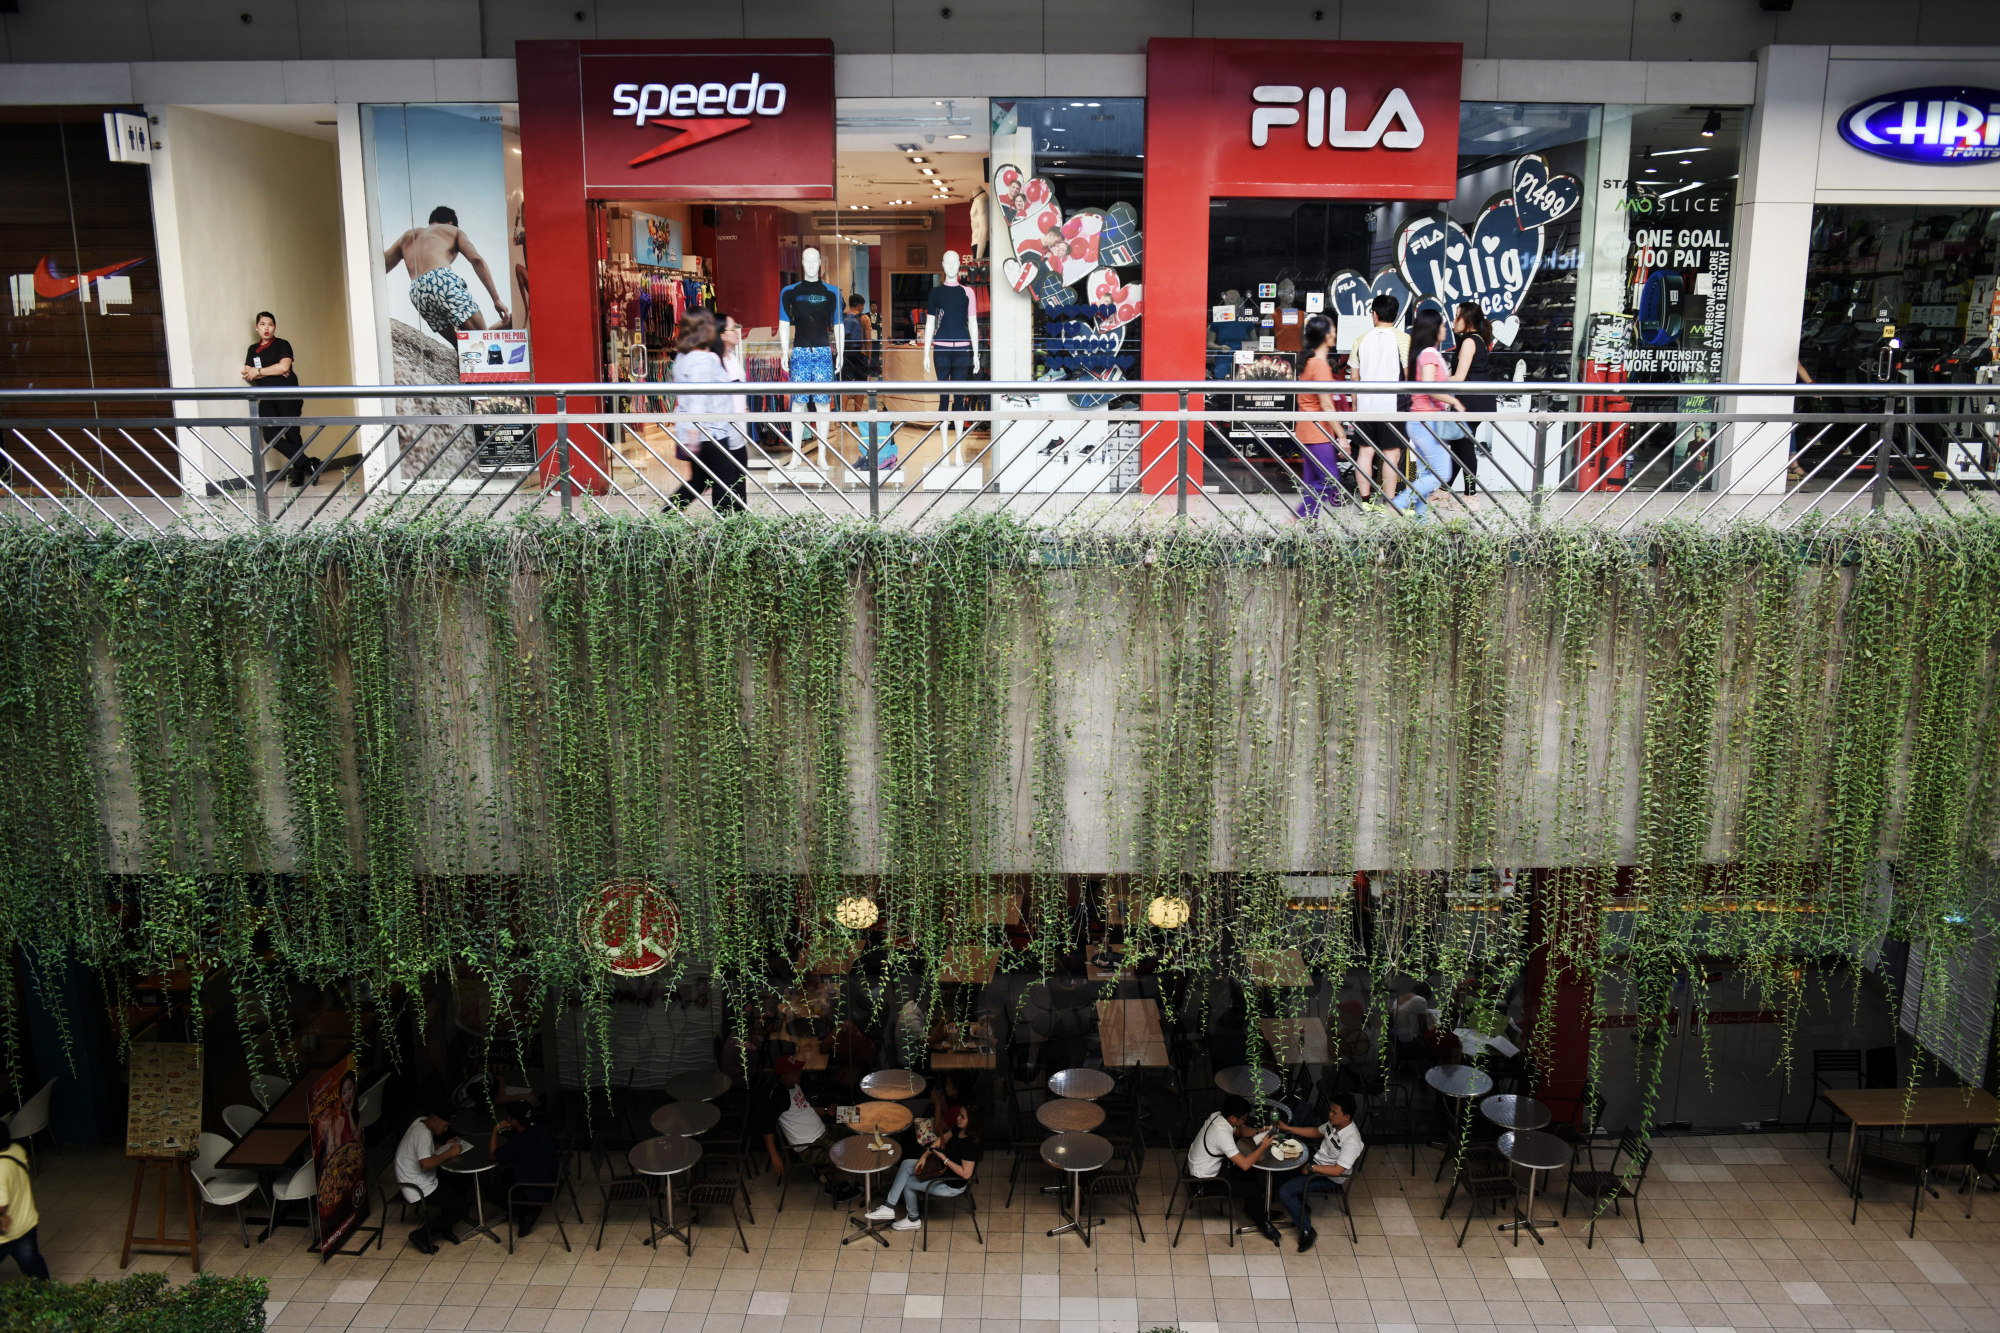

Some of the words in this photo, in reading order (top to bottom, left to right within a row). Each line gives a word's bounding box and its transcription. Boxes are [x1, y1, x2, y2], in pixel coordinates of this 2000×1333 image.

[613, 72, 787, 126] speedo
[1252, 85, 1425, 149] FILA
[1656, 198, 1720, 212] SLICE
[1409, 229, 1444, 255] FILA
[1635, 229, 1673, 248] ONE
[1678, 229, 1730, 248] GOAL.
[1634, 249, 1668, 268] 100
[1673, 249, 1702, 268] PAI
[1709, 250, 1720, 284] SCORE
[1430, 246, 1524, 301] kilig
[1717, 250, 1730, 300] HEALTHY
[1338, 280, 1356, 294] FILA
[1704, 286, 1717, 337] PERSONAL
[1713, 303, 1726, 349] STAYING
[483, 332, 492, 340] GET
[494, 332, 500, 340] IN
[502, 332, 511, 340] THE
[513, 332, 526, 340] POOL
[1703, 339, 1712, 347] A
[1624, 349, 1654, 360] MORE
[1656, 350, 1708, 361] INTENSITY.
[1710, 354, 1722, 373] FOR
[1622, 360, 1658, 372] MORE
[1660, 361, 1707, 373] POINTS.
